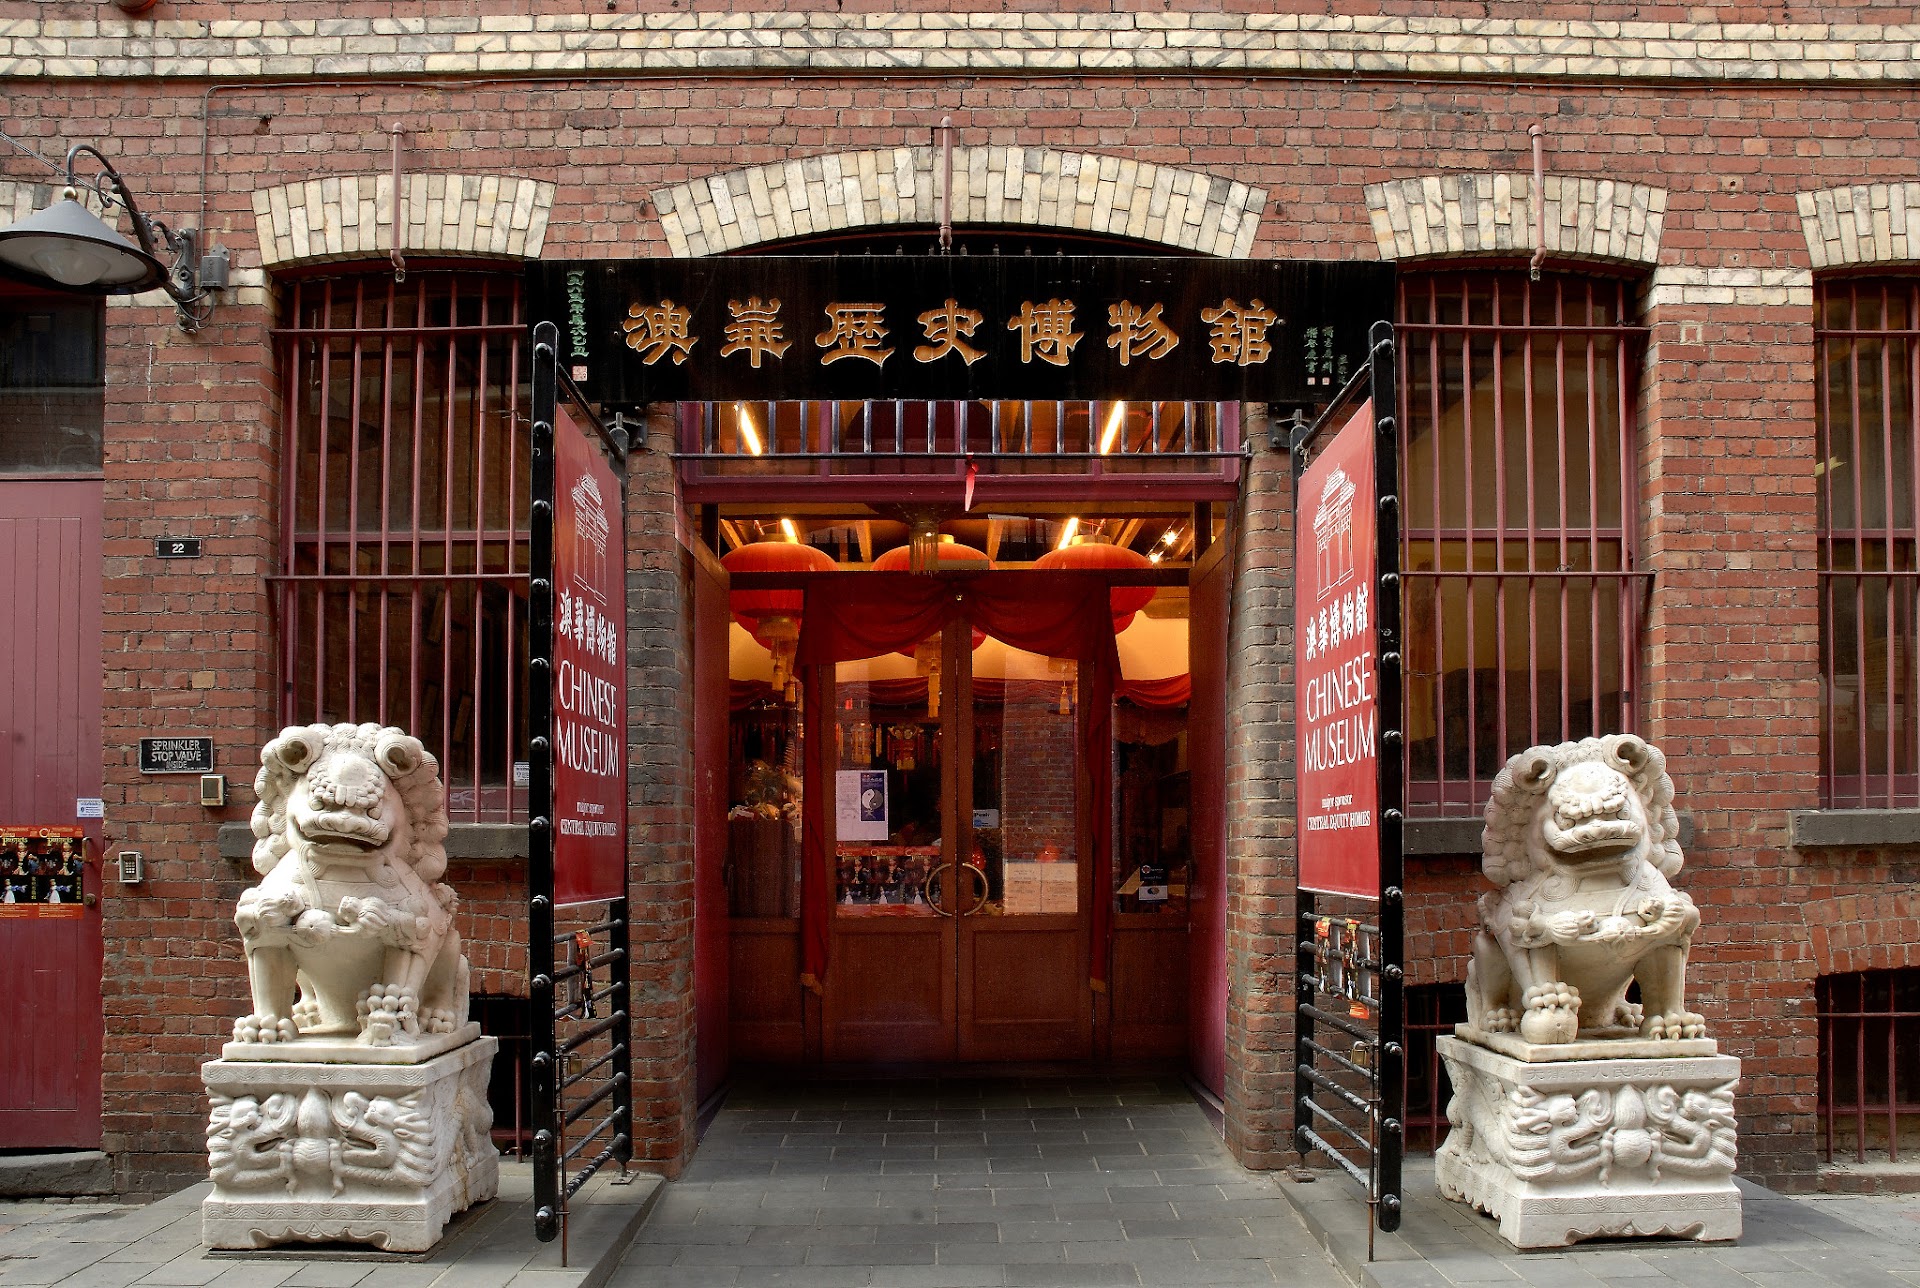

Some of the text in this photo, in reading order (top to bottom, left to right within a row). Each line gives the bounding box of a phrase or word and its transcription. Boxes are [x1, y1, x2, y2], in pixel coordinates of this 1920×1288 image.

[172, 543, 185, 554] 22
[559, 660, 617, 728] CHINESE
[1306, 652, 1372, 722] CHINESE
[152, 740, 201, 751] SPRINKLER
[557, 715, 619, 778] MUSEUM
[1304, 708, 1376, 774] MUSEUM
[151, 751, 202, 762] STOP VALVE
[166, 761, 188, 769] INSIDE
[1329, 812, 1350, 831] EQUITY
